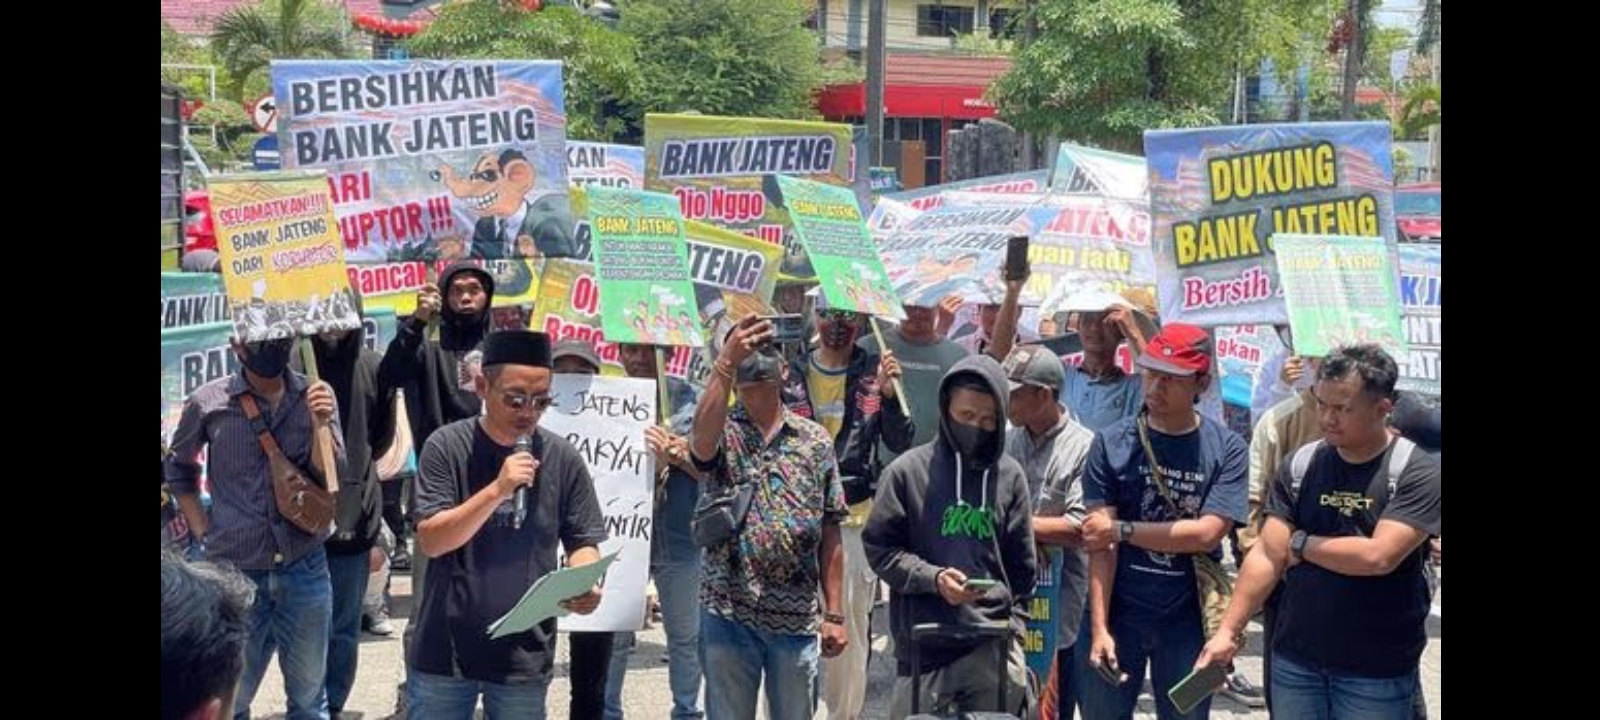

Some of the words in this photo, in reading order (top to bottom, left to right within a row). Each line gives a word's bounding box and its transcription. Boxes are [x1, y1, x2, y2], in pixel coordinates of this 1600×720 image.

[292, 65, 495, 116] BERSIHKAN
[296, 122, 392, 166] BANK
[405, 108, 536, 150] JATENG
[662, 140, 734, 176] BANK
[734, 137, 833, 172] JATENG
[1210, 143, 1335, 203] DUKUNG
[711, 189, 763, 219] Nggo
[232, 229, 269, 252] BANK
[275, 218, 326, 242] JATENG
[597, 216, 630, 234] BANK
[637, 216, 678, 236] JATENG
[1174, 214, 1259, 266] BANK
[233, 256, 263, 274] DARI
[686, 242, 764, 294] TENG
[1185, 270, 1269, 308] Bersih
[570, 390, 649, 421] JATENG
